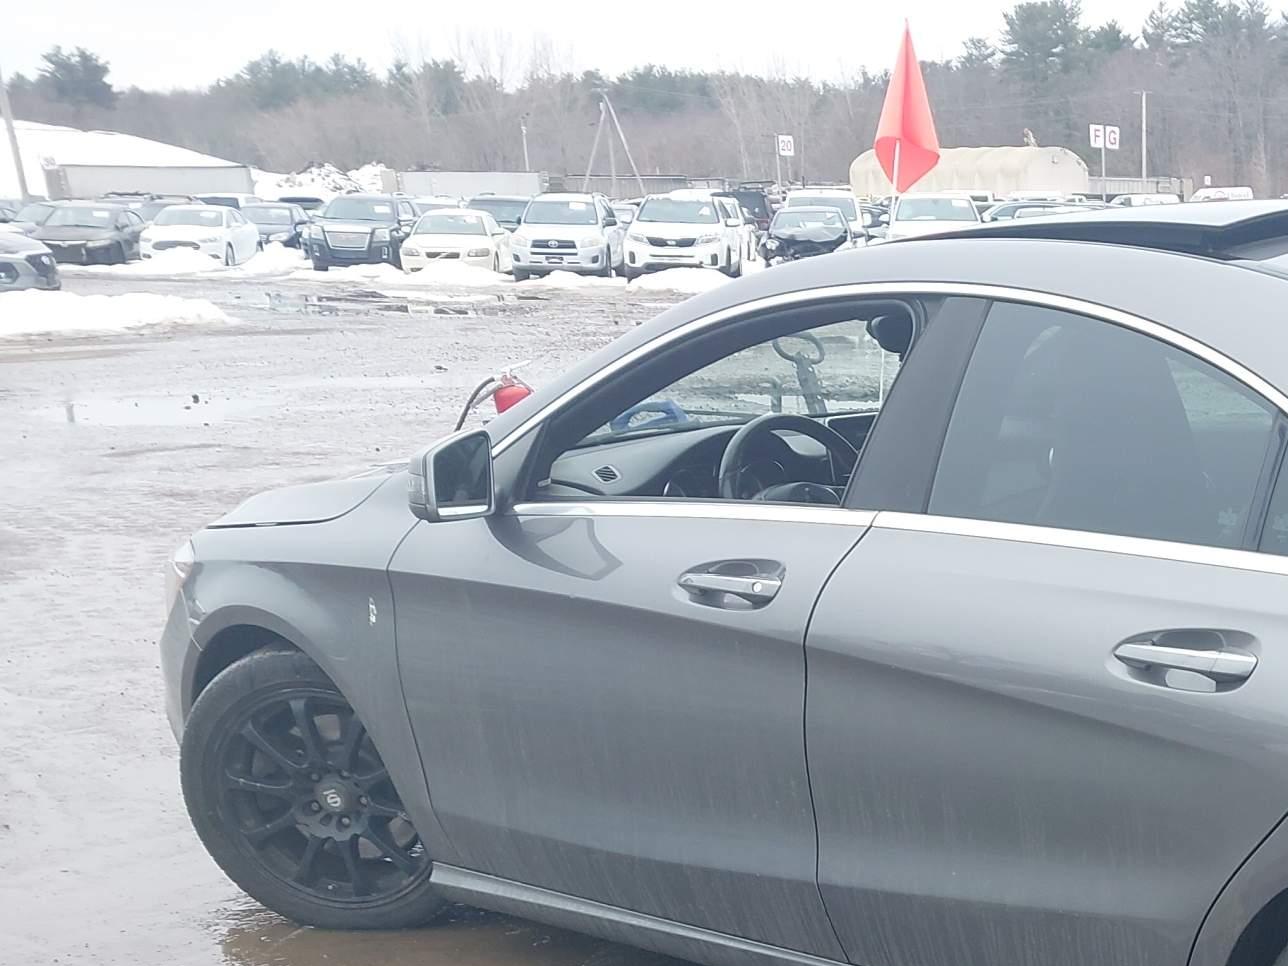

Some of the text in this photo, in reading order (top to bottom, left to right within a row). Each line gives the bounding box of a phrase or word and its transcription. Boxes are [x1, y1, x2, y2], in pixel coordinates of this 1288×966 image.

[1094, 127, 1101, 144] F
[1108, 129, 1117, 145] G
[780, 139, 793, 152] 20
